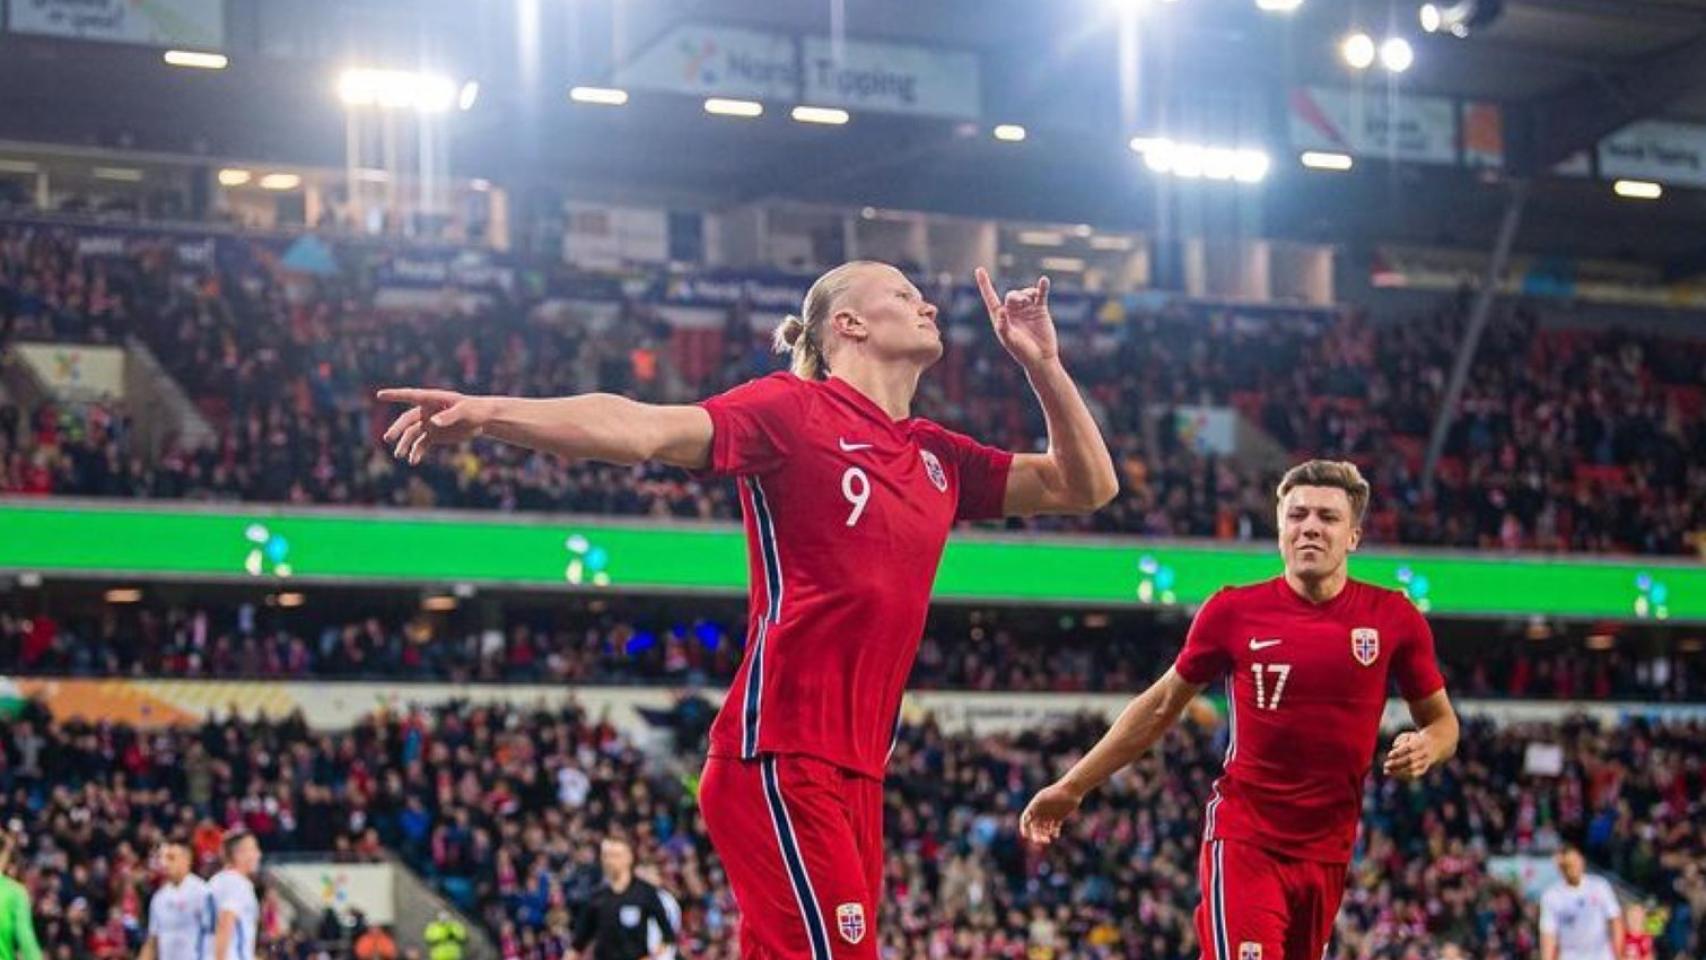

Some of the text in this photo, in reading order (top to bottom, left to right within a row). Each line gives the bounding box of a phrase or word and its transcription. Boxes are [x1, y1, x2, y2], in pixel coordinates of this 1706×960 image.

[726, 51, 919, 103] Nors Tipping
[841, 466, 871, 527] 9
[1251, 662, 1292, 710] 17
